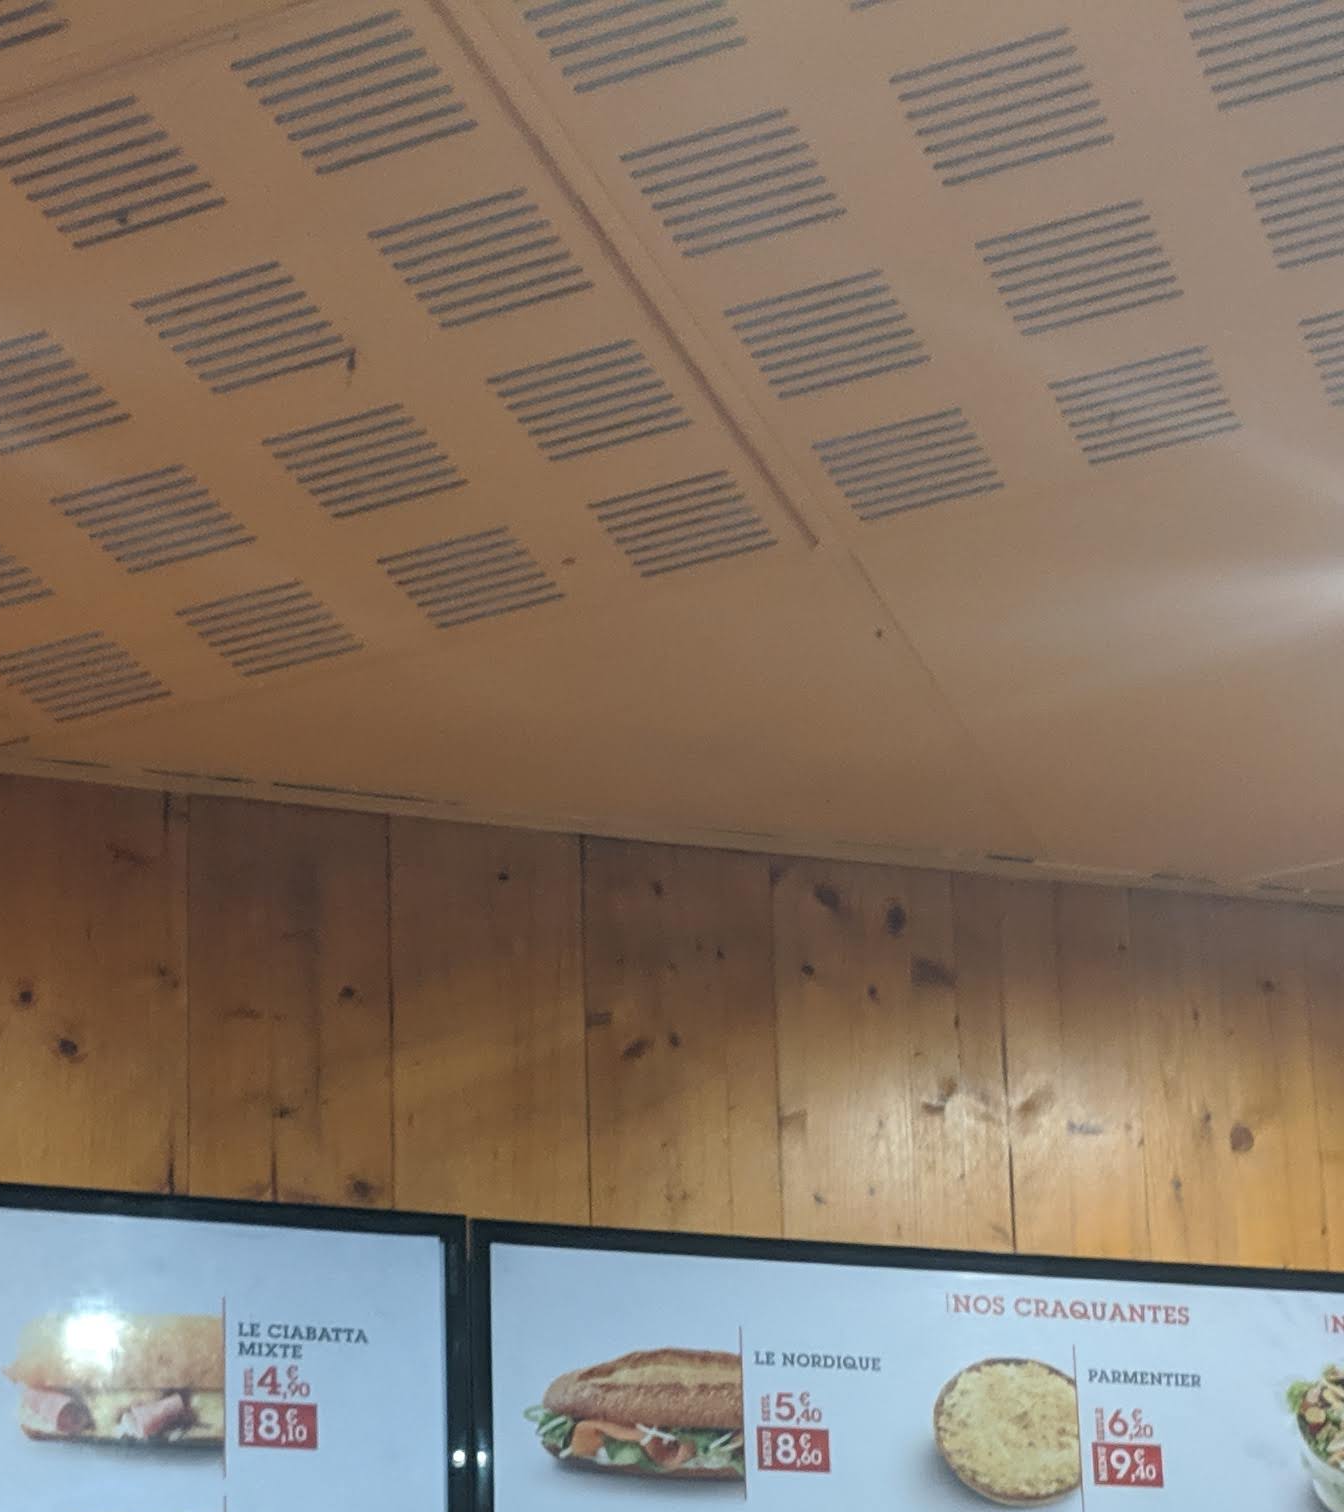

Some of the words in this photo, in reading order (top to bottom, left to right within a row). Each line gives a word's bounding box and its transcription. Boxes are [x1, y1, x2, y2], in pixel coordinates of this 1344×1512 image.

[953, 1294, 1005, 1315] NOS
[1014, 1297, 1190, 1326] CRAQUANTES
[238, 1322, 260, 1338] LE
[267, 1323, 369, 1344] CIABATTA
[238, 1341, 303, 1359] MIXTE
[754, 1351, 775, 1366] LE
[782, 1352, 881, 1371] NORDIQUE
[1088, 1368, 1201, 1388] PARMENTIER
